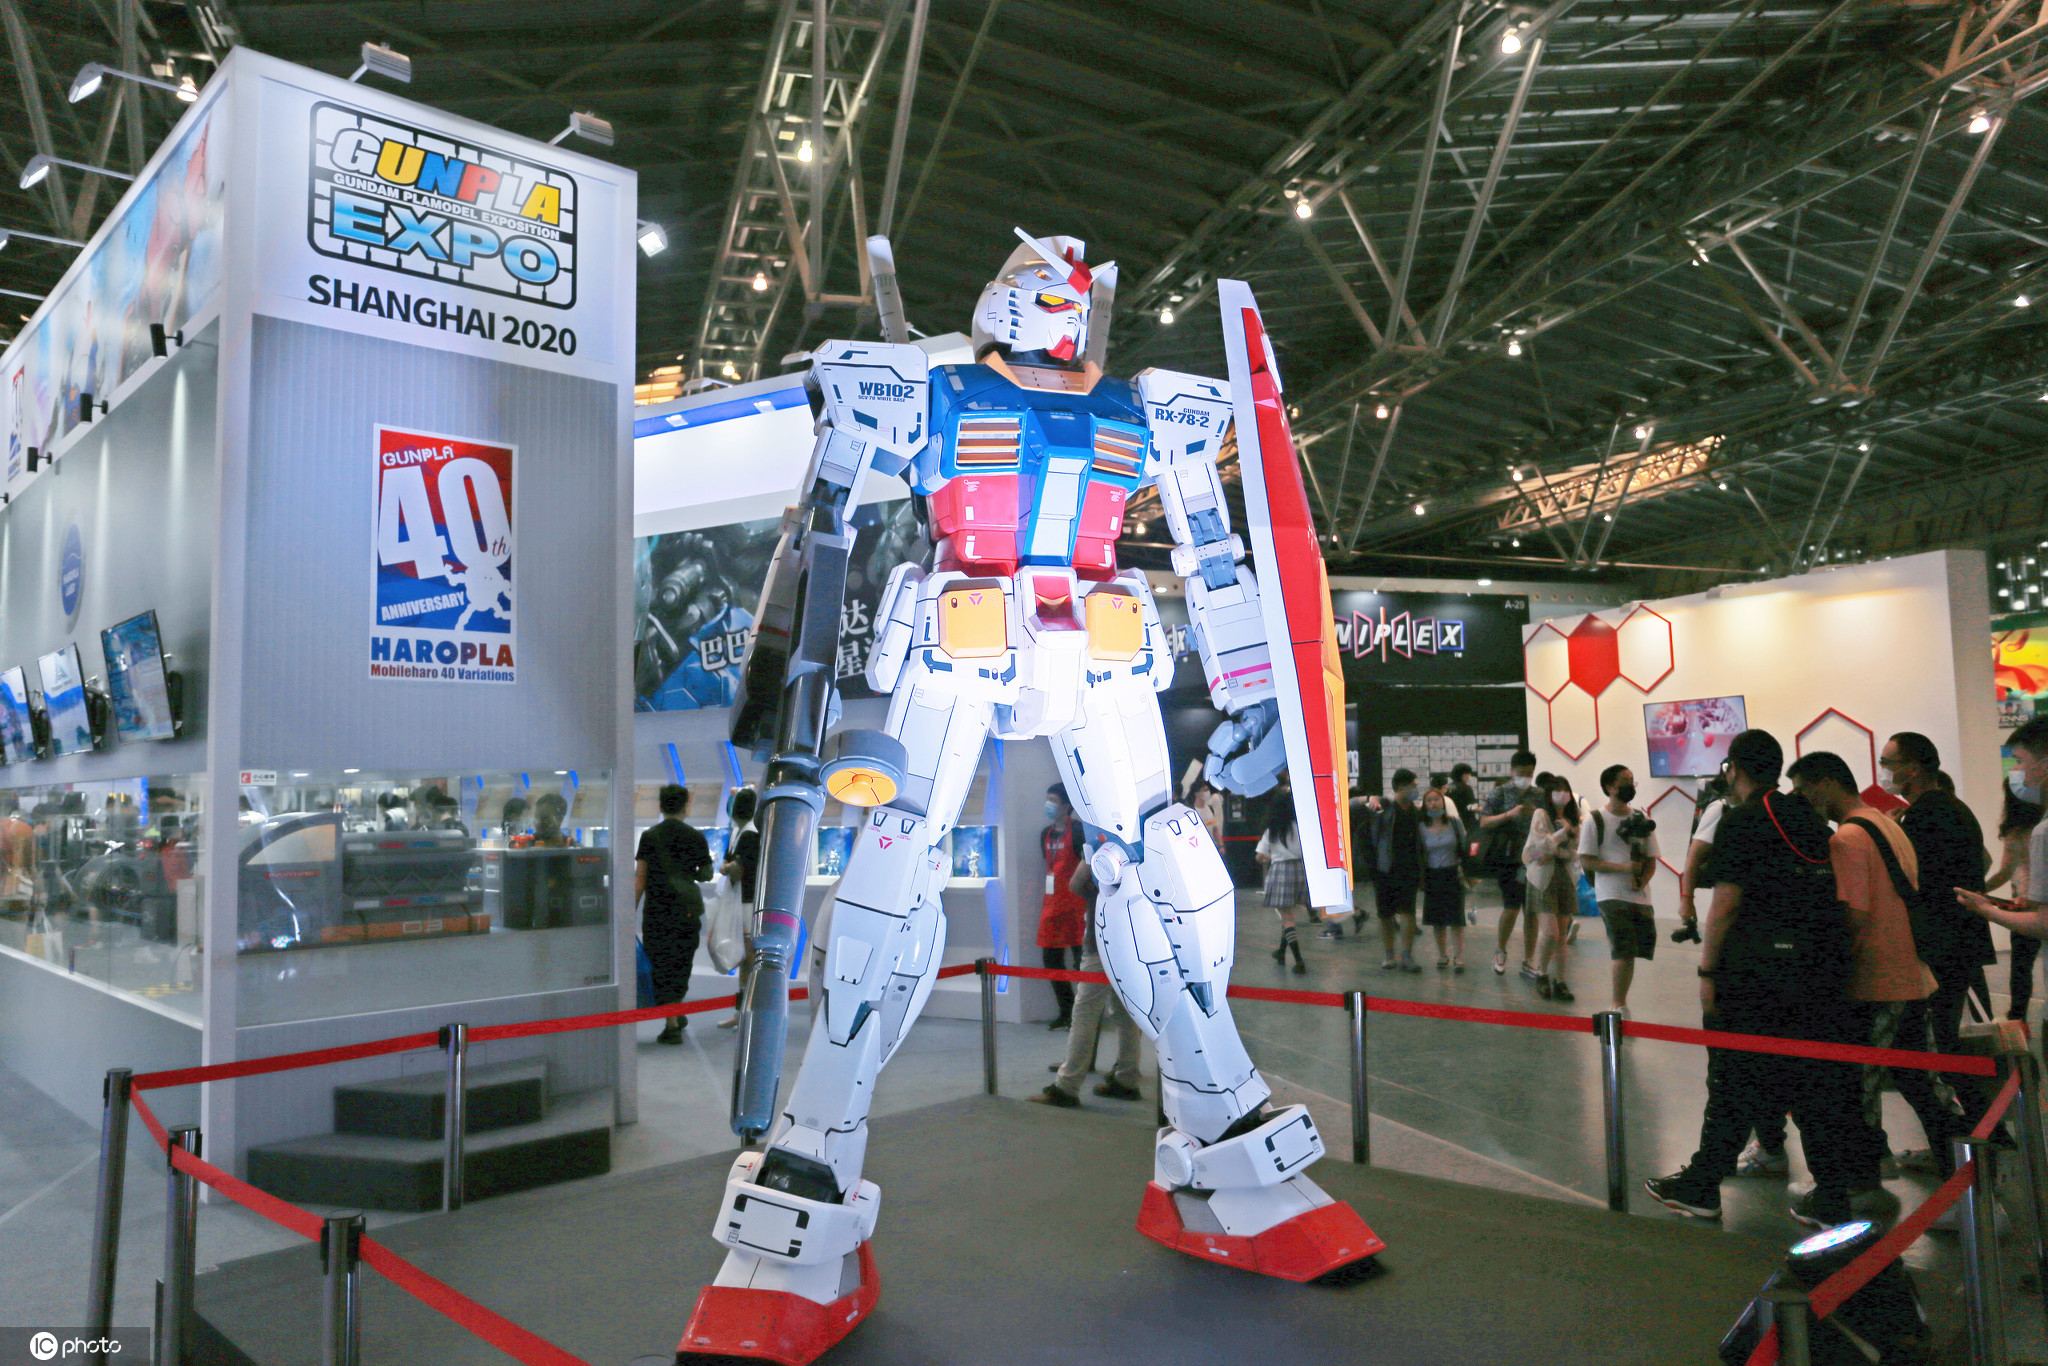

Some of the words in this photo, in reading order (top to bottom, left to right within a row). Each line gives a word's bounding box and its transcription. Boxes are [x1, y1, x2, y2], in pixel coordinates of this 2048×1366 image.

[330, 127, 561, 226] GUNPLA
[333, 173, 399, 199] GUNDAM
[403, 191, 478, 220] PLAMODEL
[481, 211, 560, 241] EXPOSITION
[331, 188, 559, 284] EXPO
[307, 274, 496, 341] SHANGHAI
[502, 315, 577, 356] 2020
[859, 381, 915, 399] WB102
[1155, 408, 1210, 428] RX-78-2
[1183, 408, 1210, 417] GUNDAM
[382, 444, 454, 467] GUNPLA
[381, 591, 466, 622] ANNIVERSARY
[371, 636, 515, 668] HAROPLA
[371, 663, 438, 679] Mobileharo
[441, 666, 455, 680] 40
[457, 667, 515, 682] Variations
